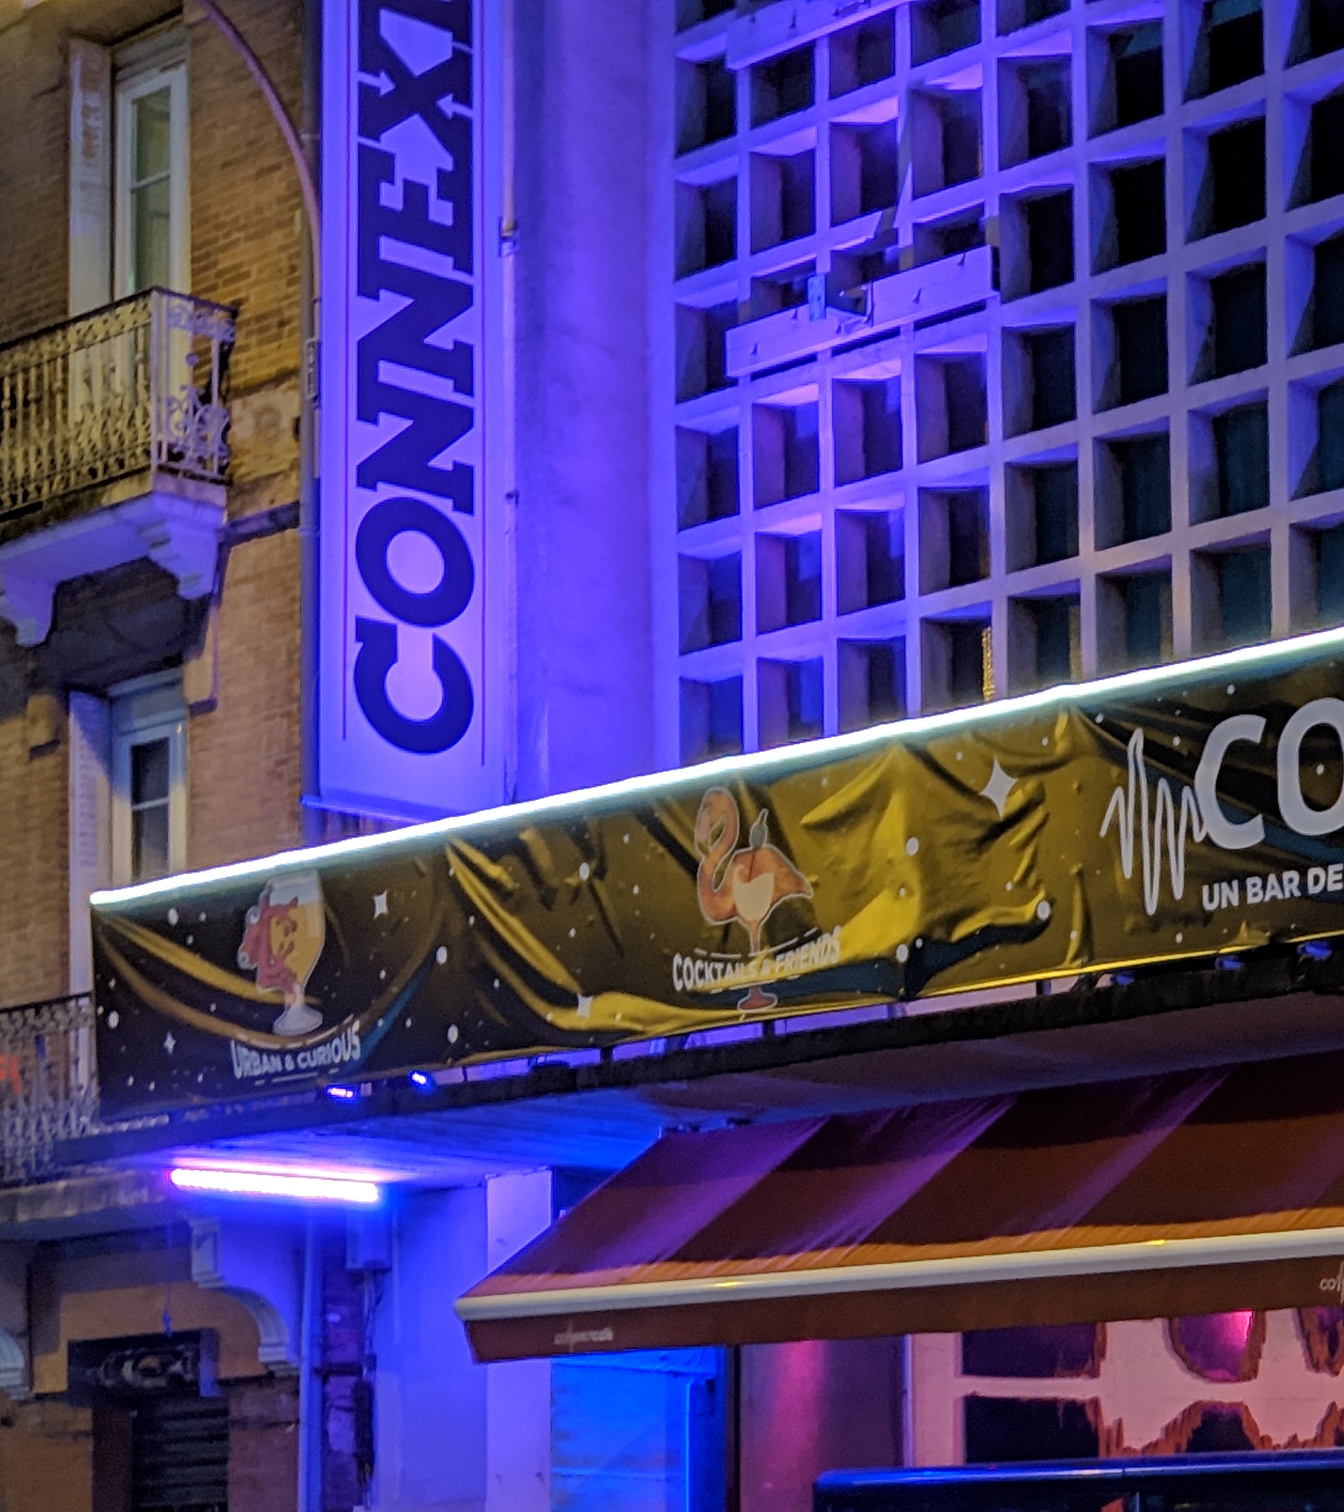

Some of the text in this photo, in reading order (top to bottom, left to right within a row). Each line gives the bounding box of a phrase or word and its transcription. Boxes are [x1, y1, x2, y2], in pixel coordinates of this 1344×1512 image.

[1201, 880, 1239, 912] UN
[1245, 872, 1302, 904] BAR
[672, 952, 756, 992] COCKTAILS
[774, 925, 843, 974] FRIENDS
[230, 1040, 283, 1079] URBAN
[297, 1019, 361, 1069] CURIOUS
